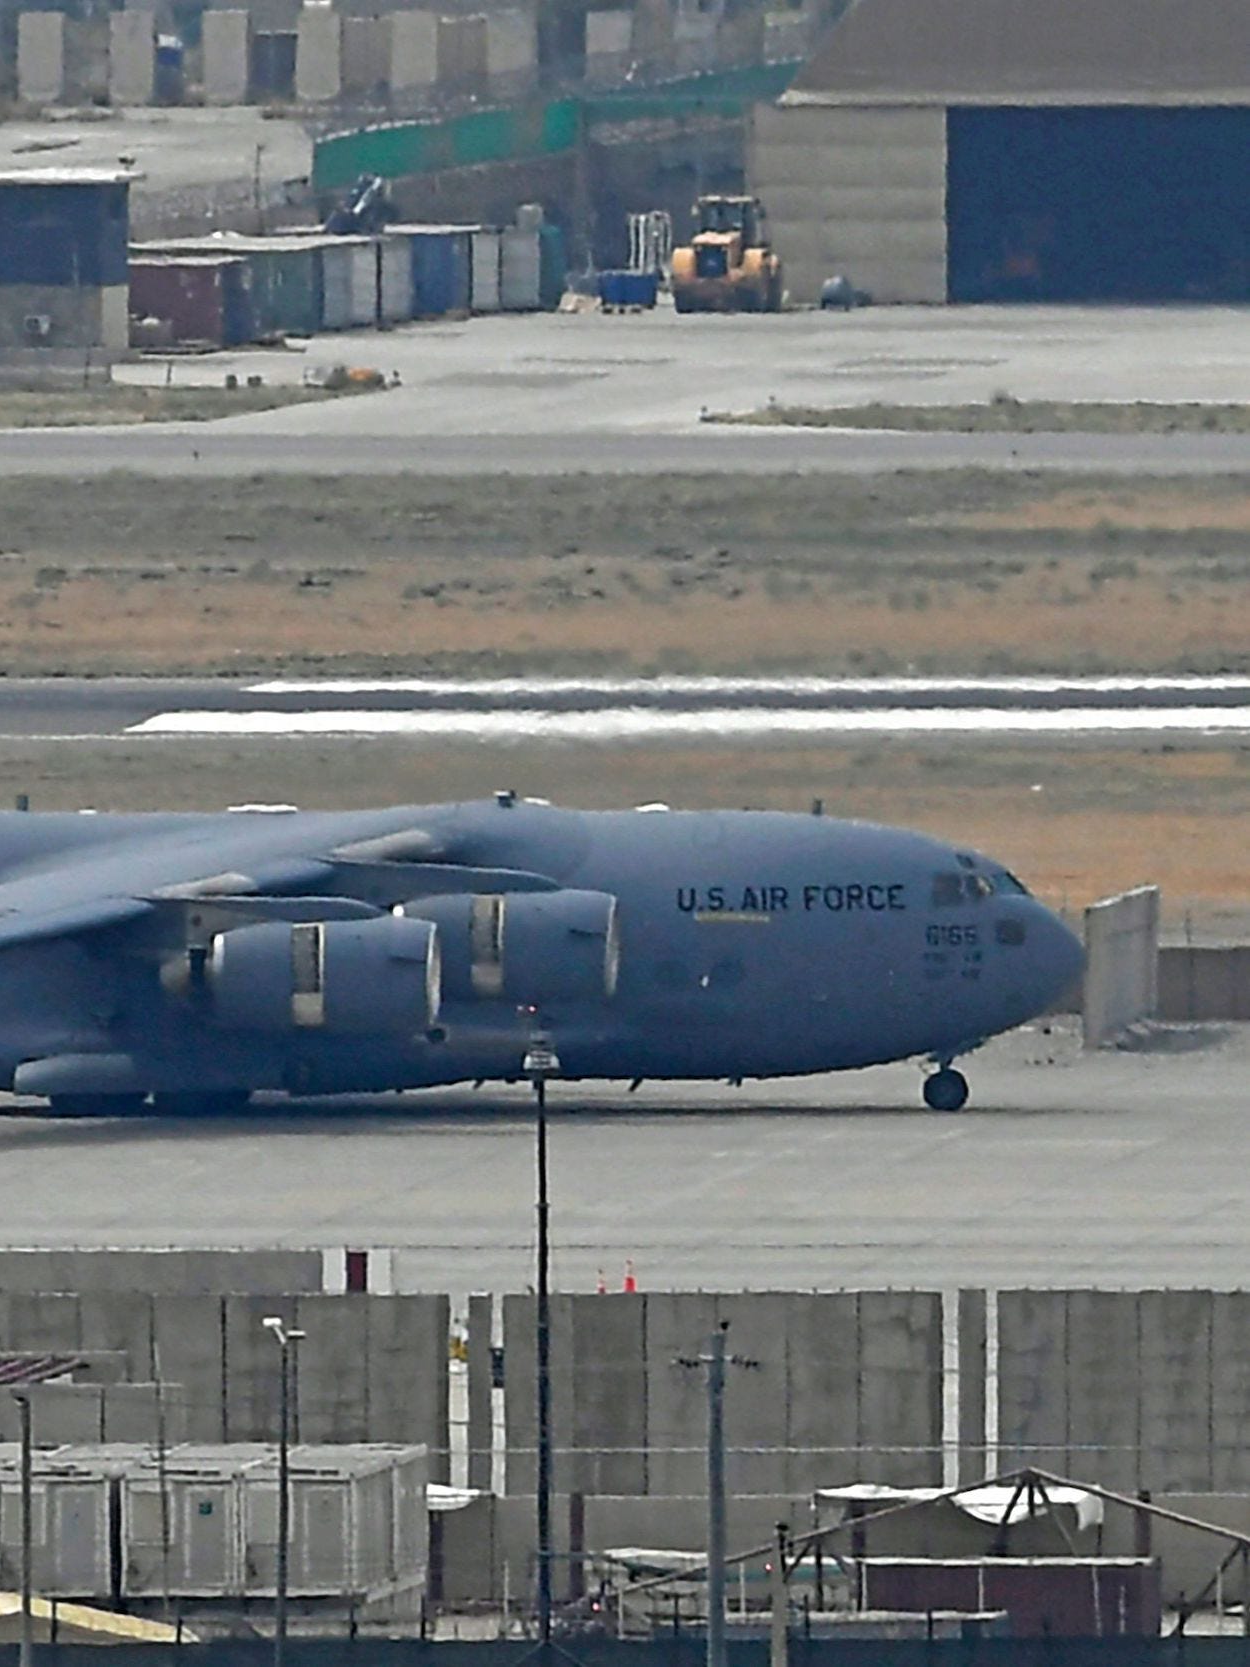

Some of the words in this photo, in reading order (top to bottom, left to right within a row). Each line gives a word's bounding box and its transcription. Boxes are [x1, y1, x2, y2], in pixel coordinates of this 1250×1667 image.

[677, 887, 734, 912] U.S.
[741, 886, 789, 911] AIR
[803, 884, 906, 911] FORCE
